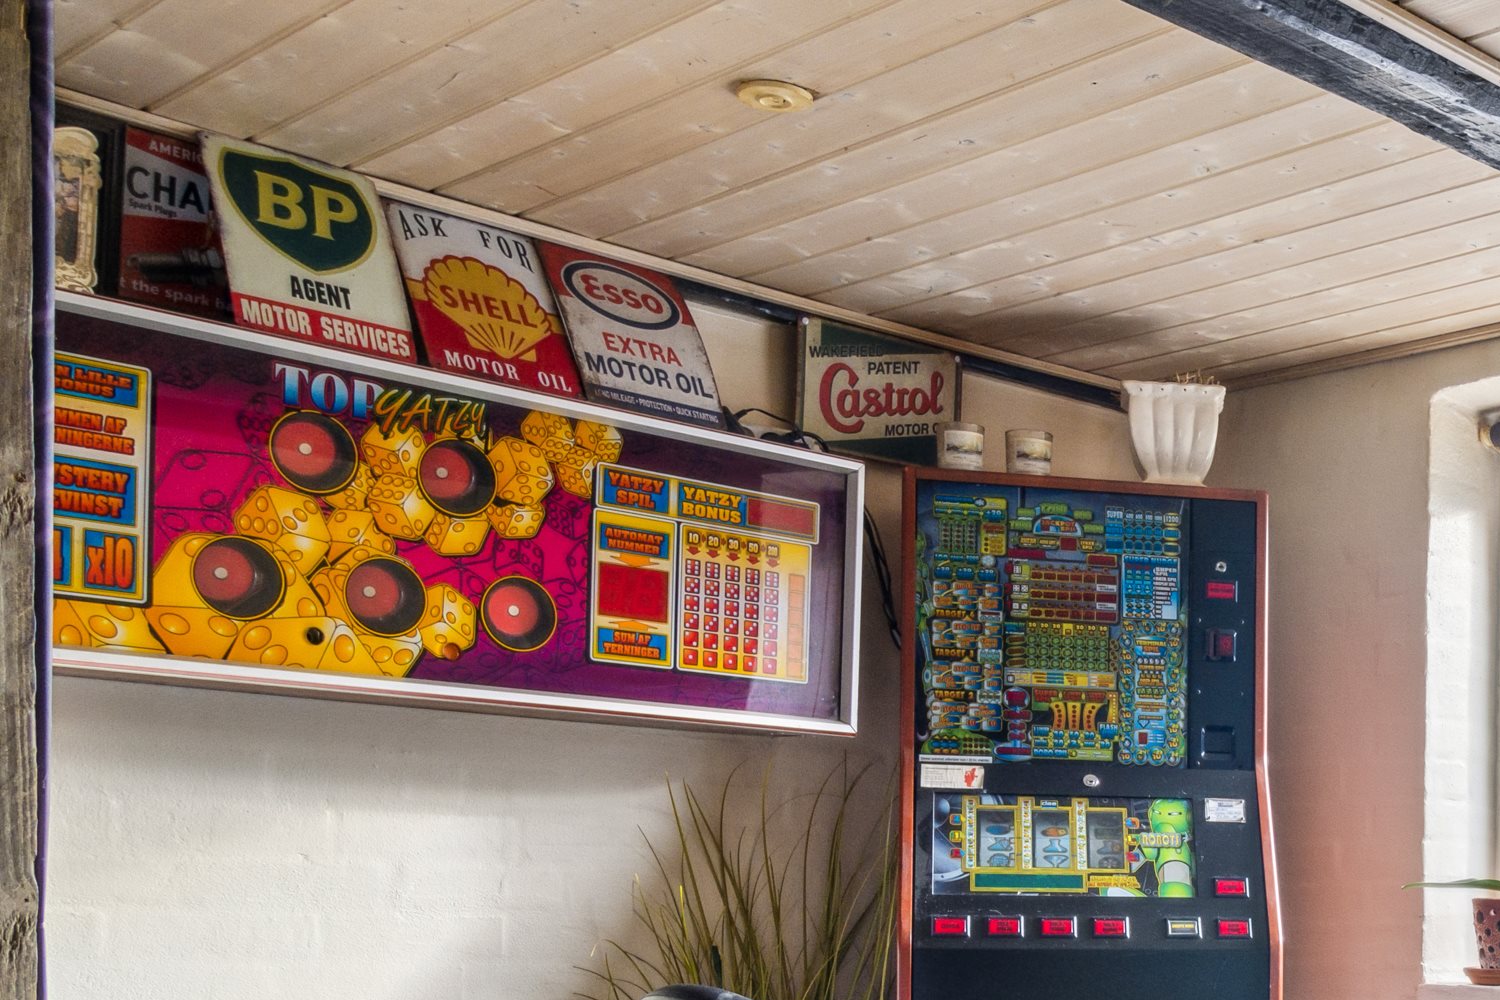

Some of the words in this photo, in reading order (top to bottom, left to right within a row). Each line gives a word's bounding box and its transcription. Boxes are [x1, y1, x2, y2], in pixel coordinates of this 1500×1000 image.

[129, 198, 152, 212] Spark
[153, 204, 177, 219] Plugs
[253, 169, 358, 241] BP
[399, 209, 448, 241] ASK
[477, 229, 535, 273] FOR
[132, 279, 159, 295] the
[290, 275, 351, 310] AGENT
[579, 274, 664, 315] ESSO
[439, 285, 538, 329] SHELL
[240, 298, 313, 336] MOTOR
[320, 316, 410, 357] SERVICES
[602, 331, 683, 367] EXTRA
[809, 345, 884, 358] WAKEFIELD
[55, 364, 70, 378] N
[75, 367, 132, 389] LILLE
[443, 349, 520, 381] MOTOR
[538, 371, 572, 393] OIL
[584, 351, 672, 389] MOTOR
[675, 372, 714, 399] OIL
[867, 362, 920, 375] PATENT
[274, 363, 385, 420] TOP
[819, 362, 944, 434] Castrol
[638, 398, 673, 413] PROTECTION
[675, 406, 692, 417] QUICK
[55, 407, 103, 431] MMEN
[105, 416, 127, 435] AF
[884, 423, 929, 437] MOTOR
[55, 427, 135, 454] NINGERNE
[608, 471, 664, 494] YATZY
[616, 489, 655, 509] SPIL
[683, 486, 742, 509] YATZY
[682, 502, 742, 524] BONUS
[605, 527, 664, 544] AUTOMAT
[607, 538, 660, 555] NUMMER
[688, 532, 699, 544] 10
[708, 536, 719, 547] 20
[728, 538, 739, 550] 30
[748, 542, 759, 553] 50
[87, 536, 134, 590] x10
[935, 609, 966, 618] TARGET
[614, 631, 636, 643] SUM
[637, 634, 651, 645] AF
[603, 642, 660, 659] TERNINGER
[935, 648, 966, 657] TARGET
[935, 690, 965, 698] TARGET
